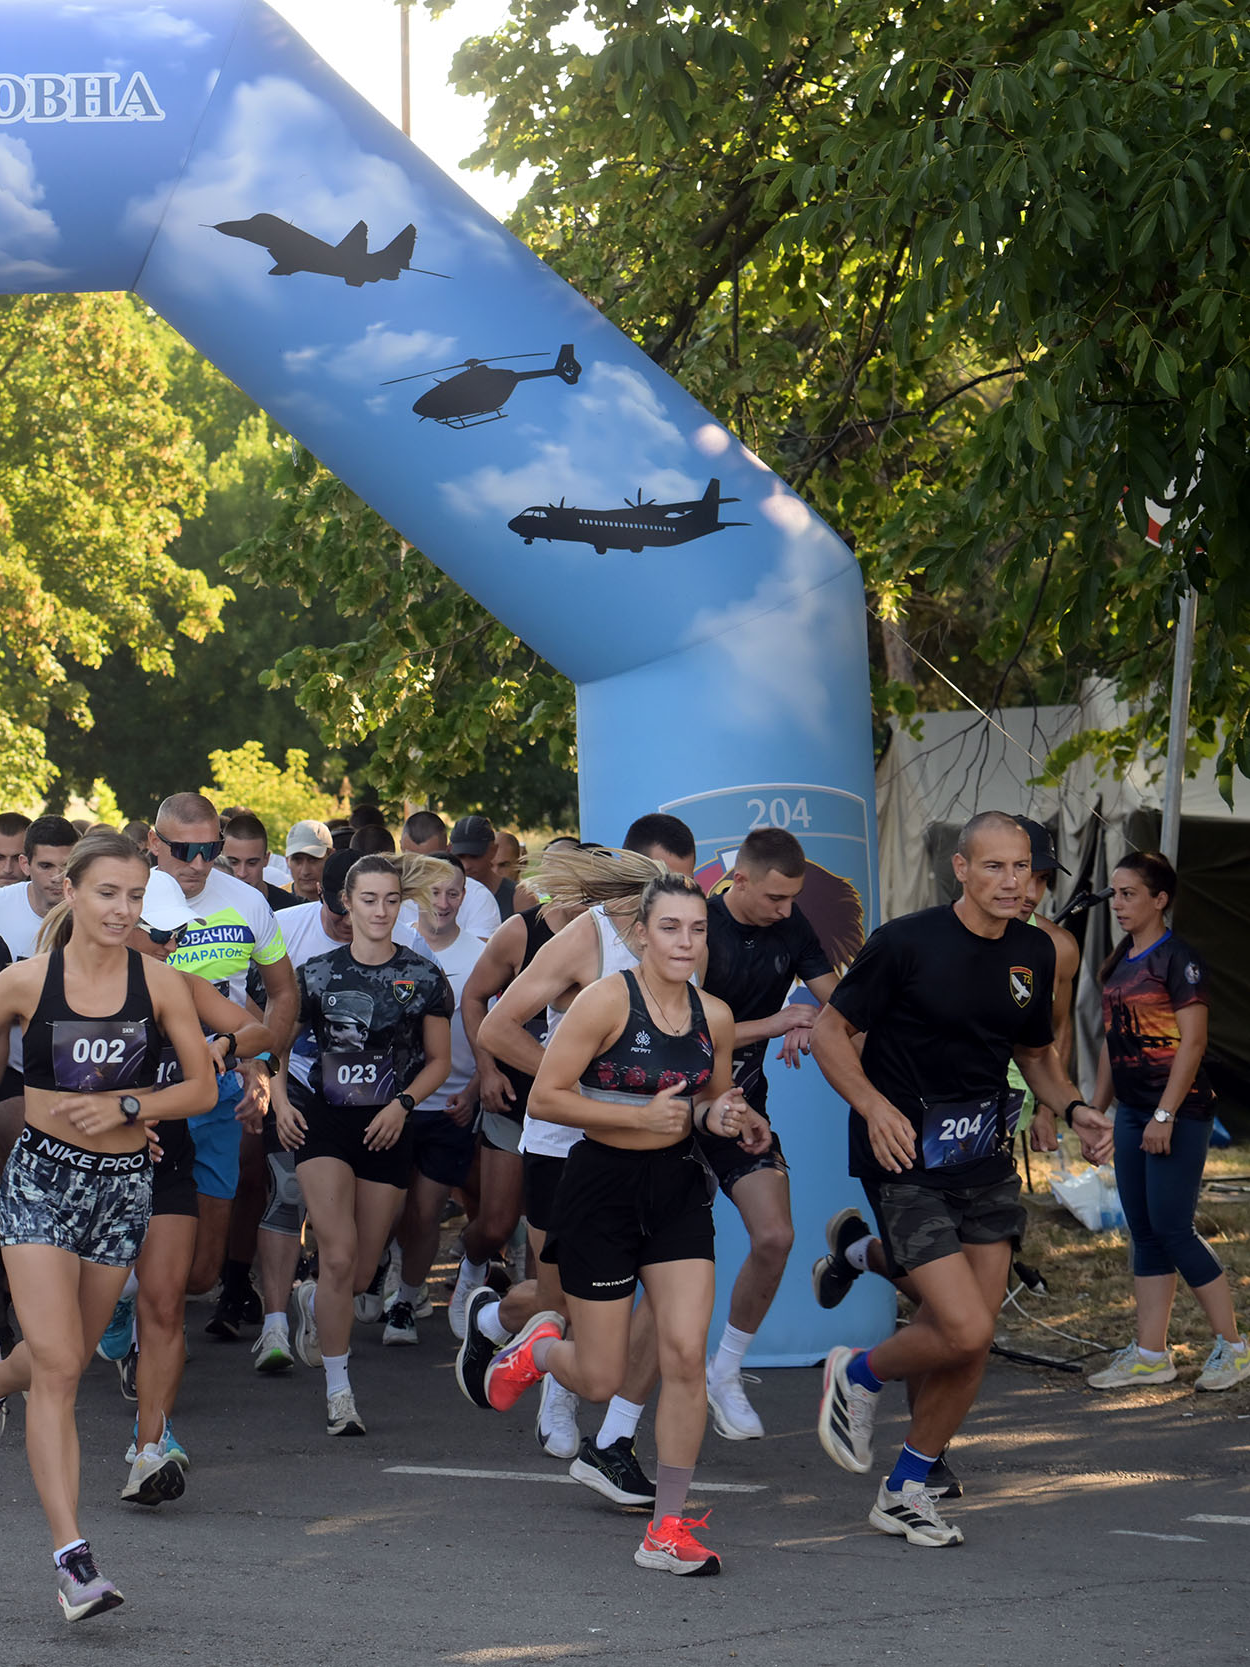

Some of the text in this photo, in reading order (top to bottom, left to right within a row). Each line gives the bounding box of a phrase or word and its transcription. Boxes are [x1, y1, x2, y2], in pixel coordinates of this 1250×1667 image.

[746, 797, 813, 831] 204
[72, 1038, 126, 1064] 002
[337, 1064, 377, 1084] 023
[939, 1113, 983, 1141] 204
[36, 1138, 145, 1172] NIKE PRO
